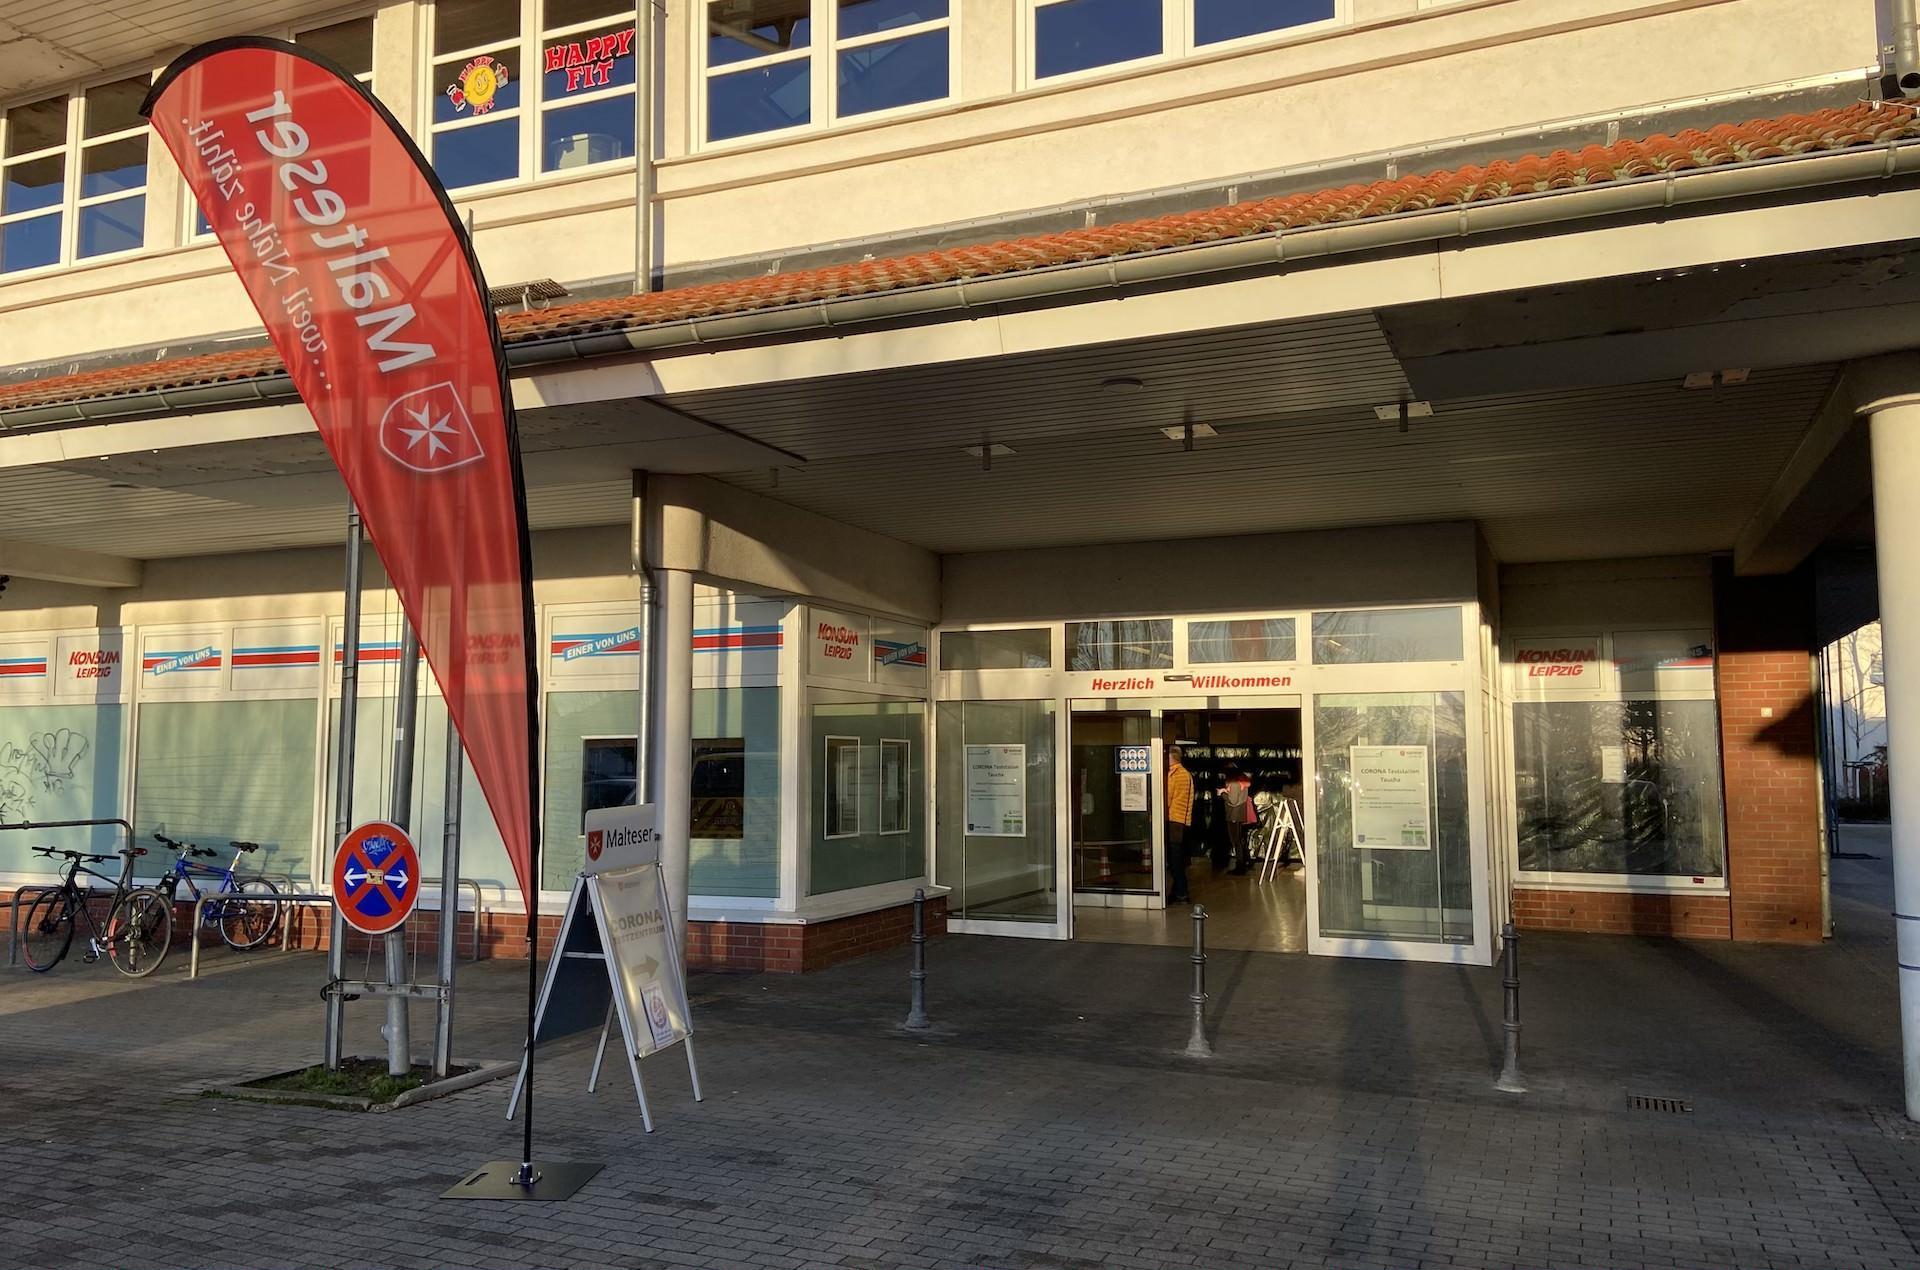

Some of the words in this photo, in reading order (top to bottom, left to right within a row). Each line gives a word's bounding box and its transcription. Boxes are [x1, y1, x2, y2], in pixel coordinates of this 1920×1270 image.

[544, 28, 635, 74] HAPPY
[459, 55, 495, 83] HAPPY
[565, 59, 614, 92] FIT
[567, 643, 594, 659] EINER
[595, 637, 614, 650] VON
[617, 631, 637, 643] UNS
[818, 623, 859, 646] KONSUM
[69, 650, 120, 665] KONSUM
[156, 660, 178, 674] EINER
[178, 655, 194, 667] VON
[195, 649, 210, 661] UNS
[824, 643, 852, 660] LEIPZIG
[1515, 649, 1596, 663] KONSUM
[76, 667, 111, 679] LEIPZIG
[1529, 664, 1584, 677] LEIPZIG
[1092, 677, 1154, 691] Herzlich
[1191, 675, 1292, 689] Willkommen
[606, 826, 653, 849] Malteser
